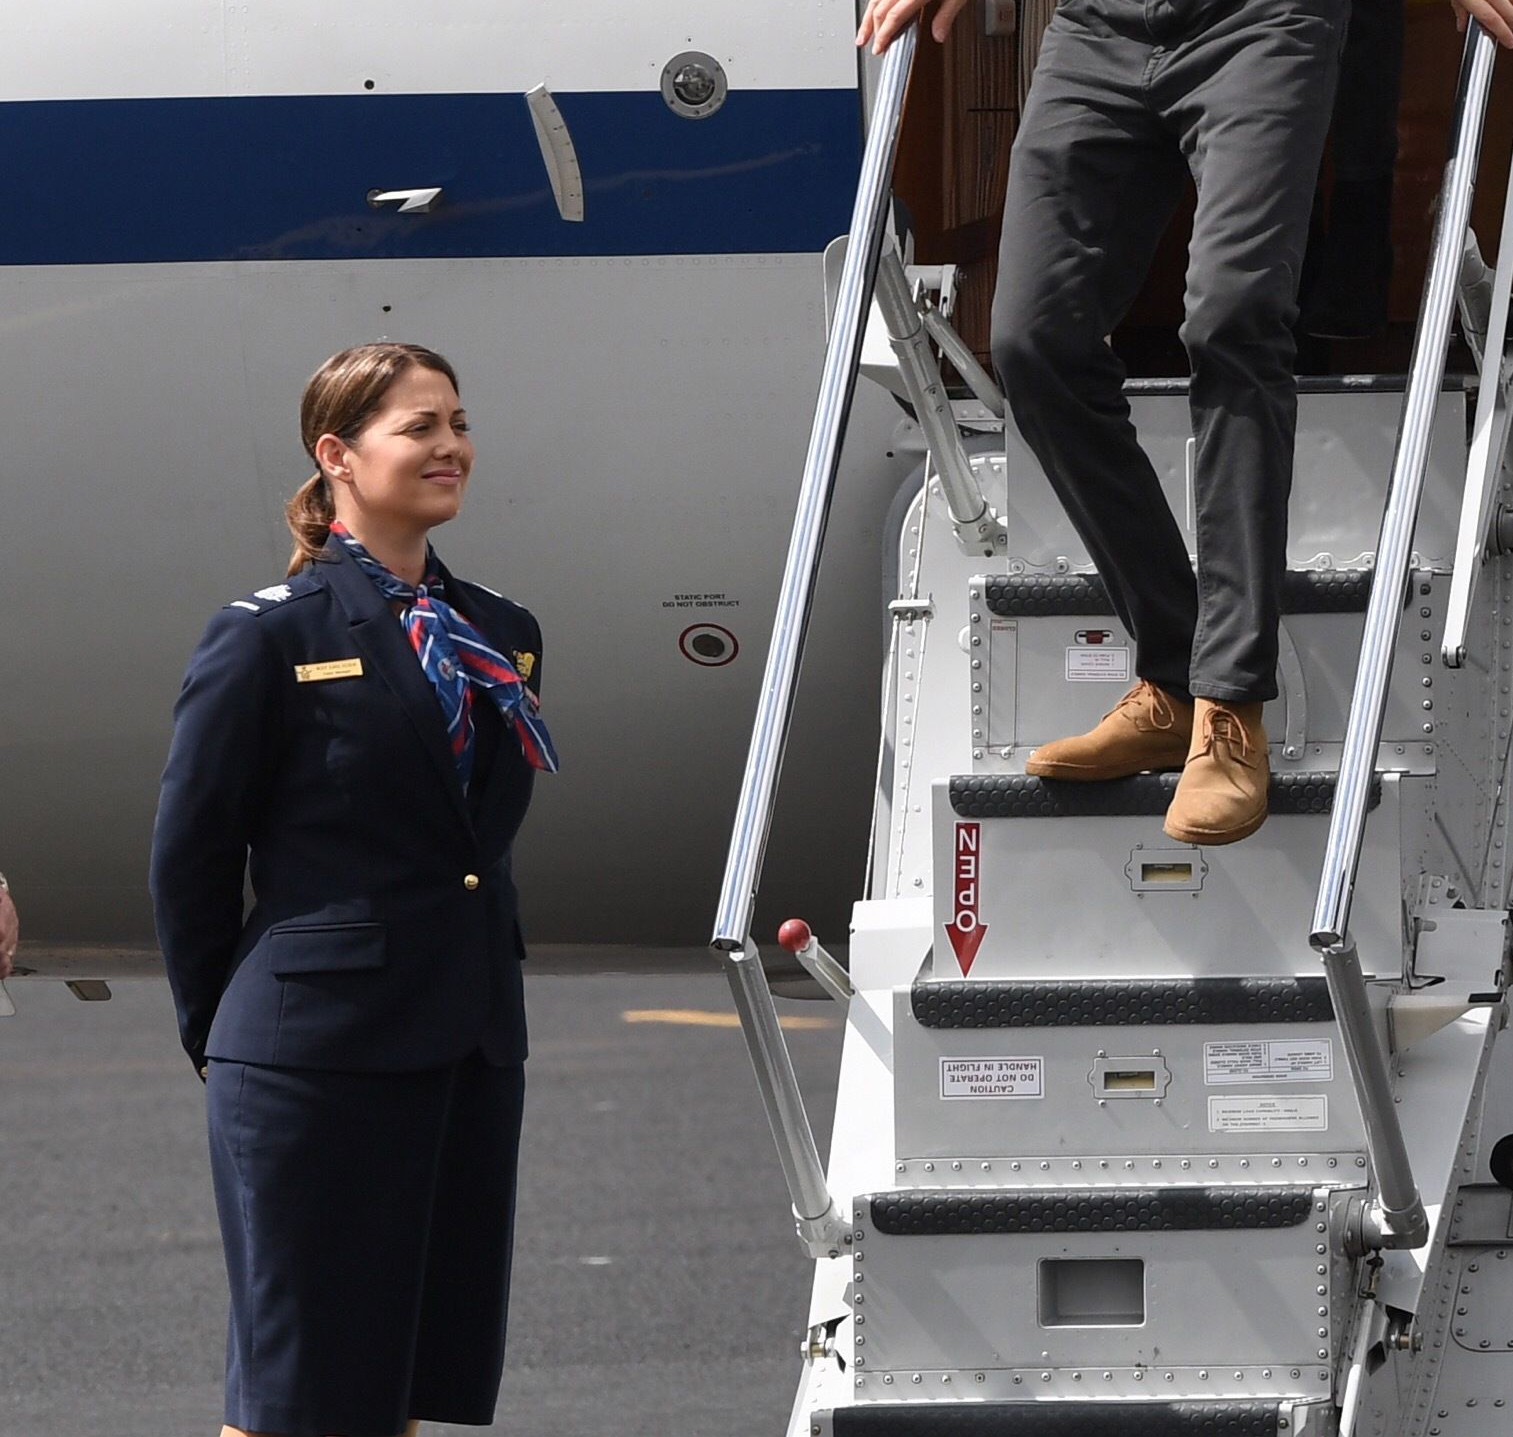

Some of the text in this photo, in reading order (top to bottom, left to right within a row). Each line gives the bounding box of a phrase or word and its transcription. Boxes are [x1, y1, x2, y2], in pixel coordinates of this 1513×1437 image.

[955, 827, 977, 933] OPEN
[946, 1062, 1037, 1072] HANDLE IN FLIGHT
[949, 1073, 1035, 1083] DO NOT OPERATE
[969, 1084, 1015, 1094] CAUTION
